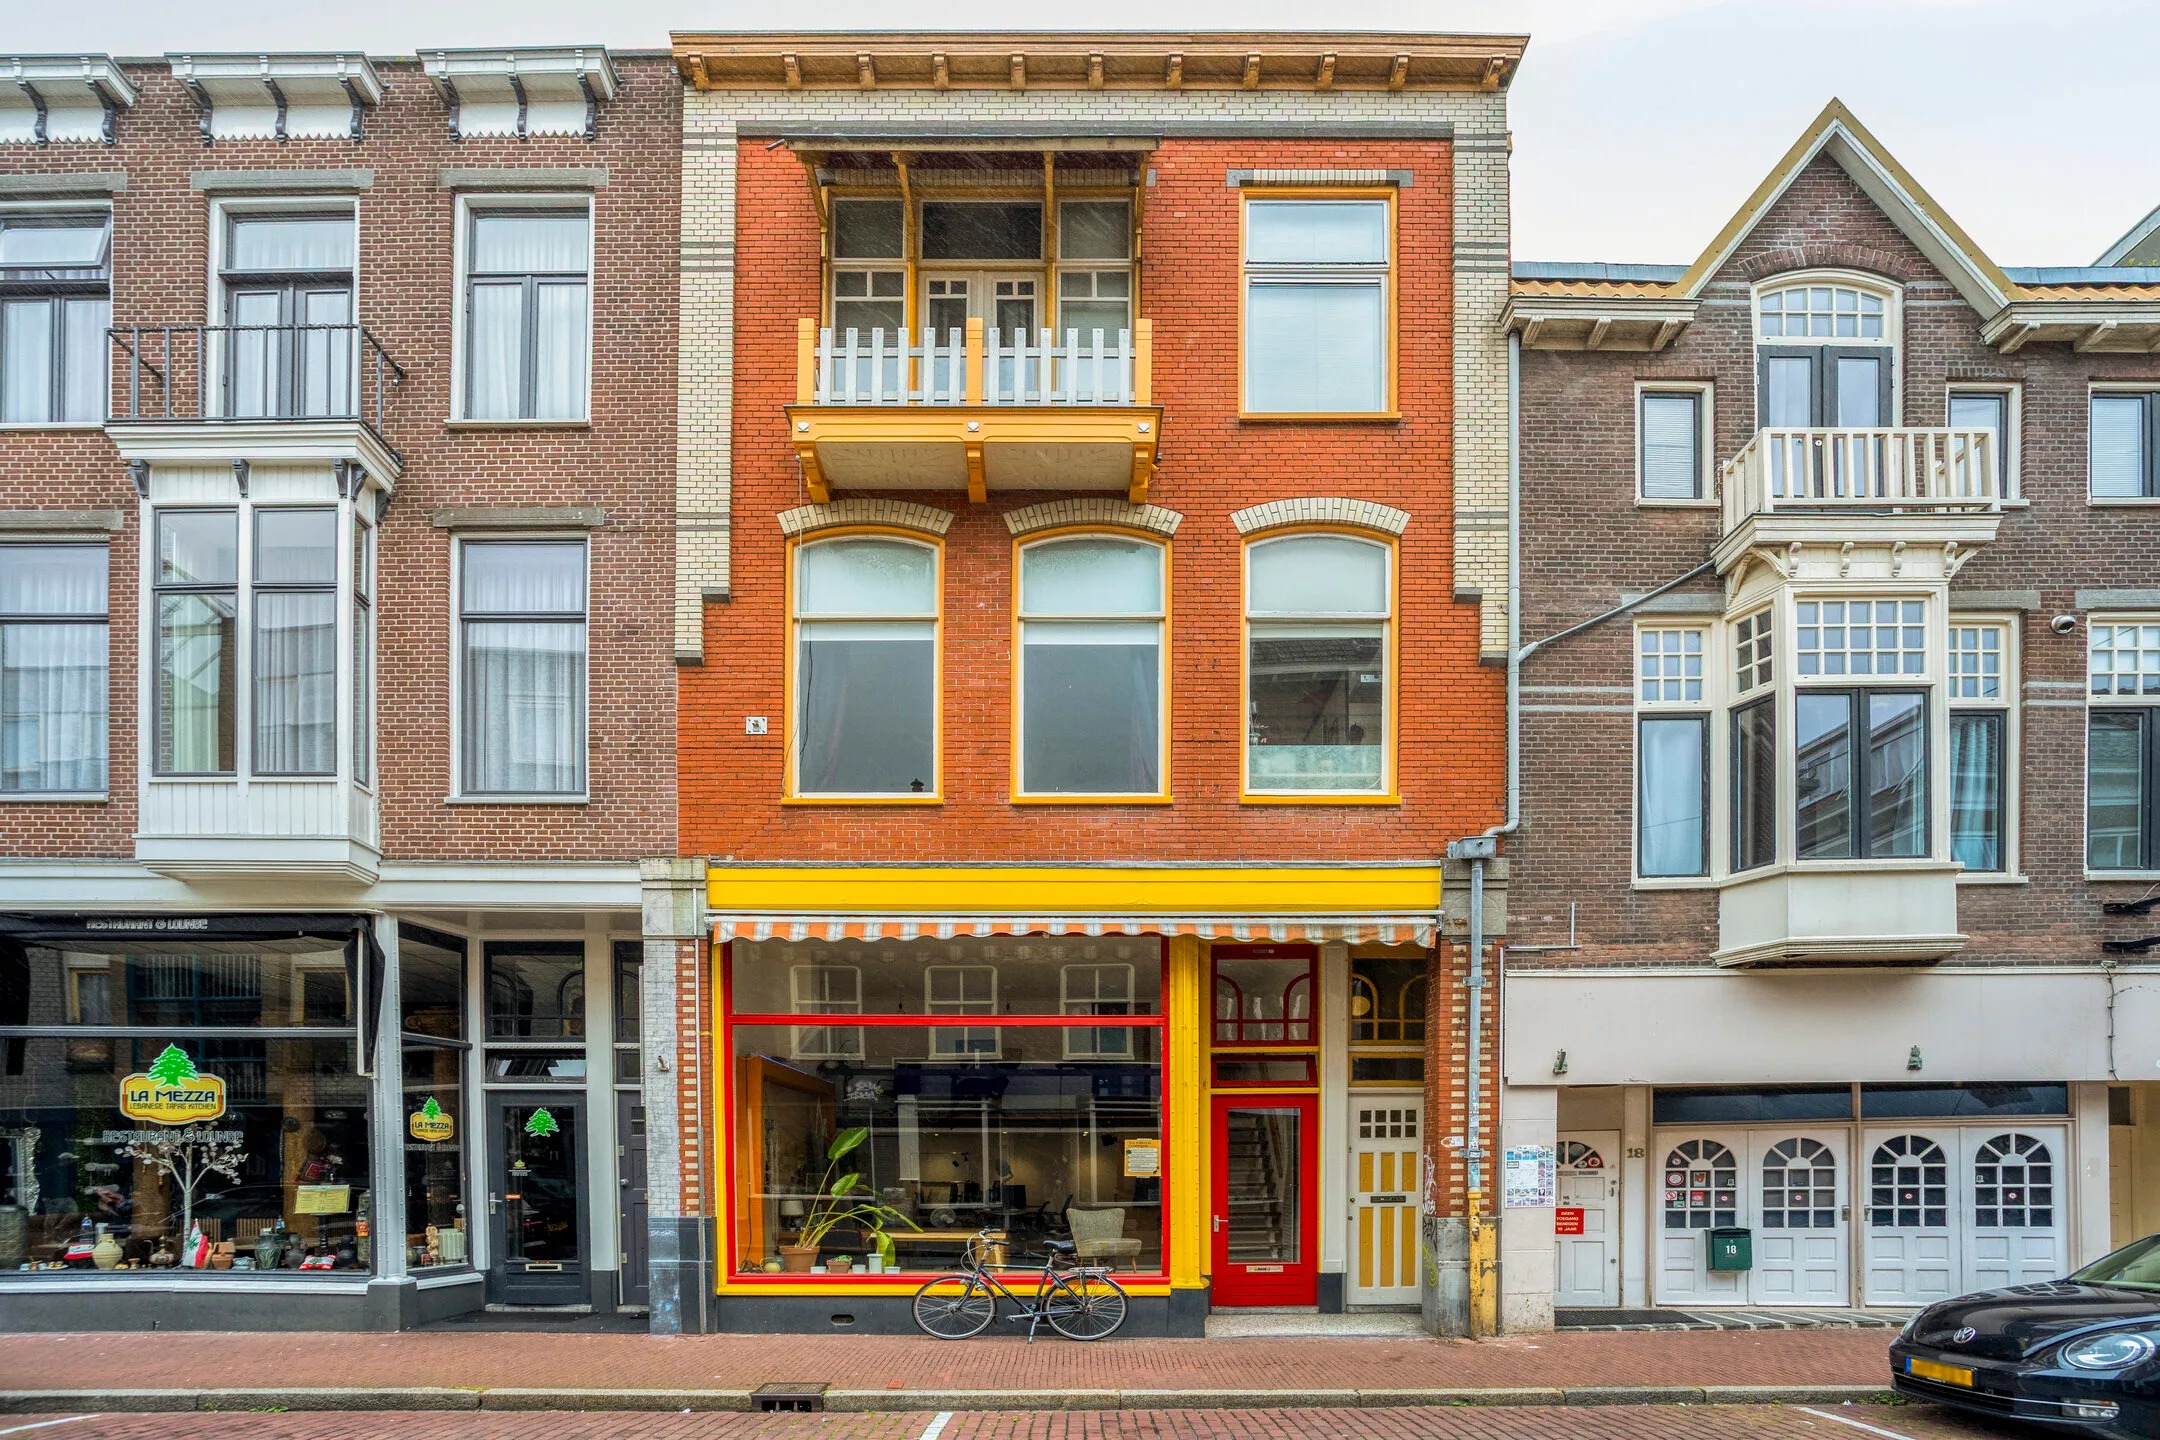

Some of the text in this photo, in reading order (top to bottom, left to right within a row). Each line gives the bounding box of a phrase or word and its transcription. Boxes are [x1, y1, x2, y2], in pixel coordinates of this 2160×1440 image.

[130, 1091, 215, 1102] LA MEZZA
[102, 1130, 182, 1143] RESTAURANT
[183, 1128, 195, 1143] &
[1626, 1147, 1645, 1159] 18
[1725, 1245, 1737, 1254] 18
